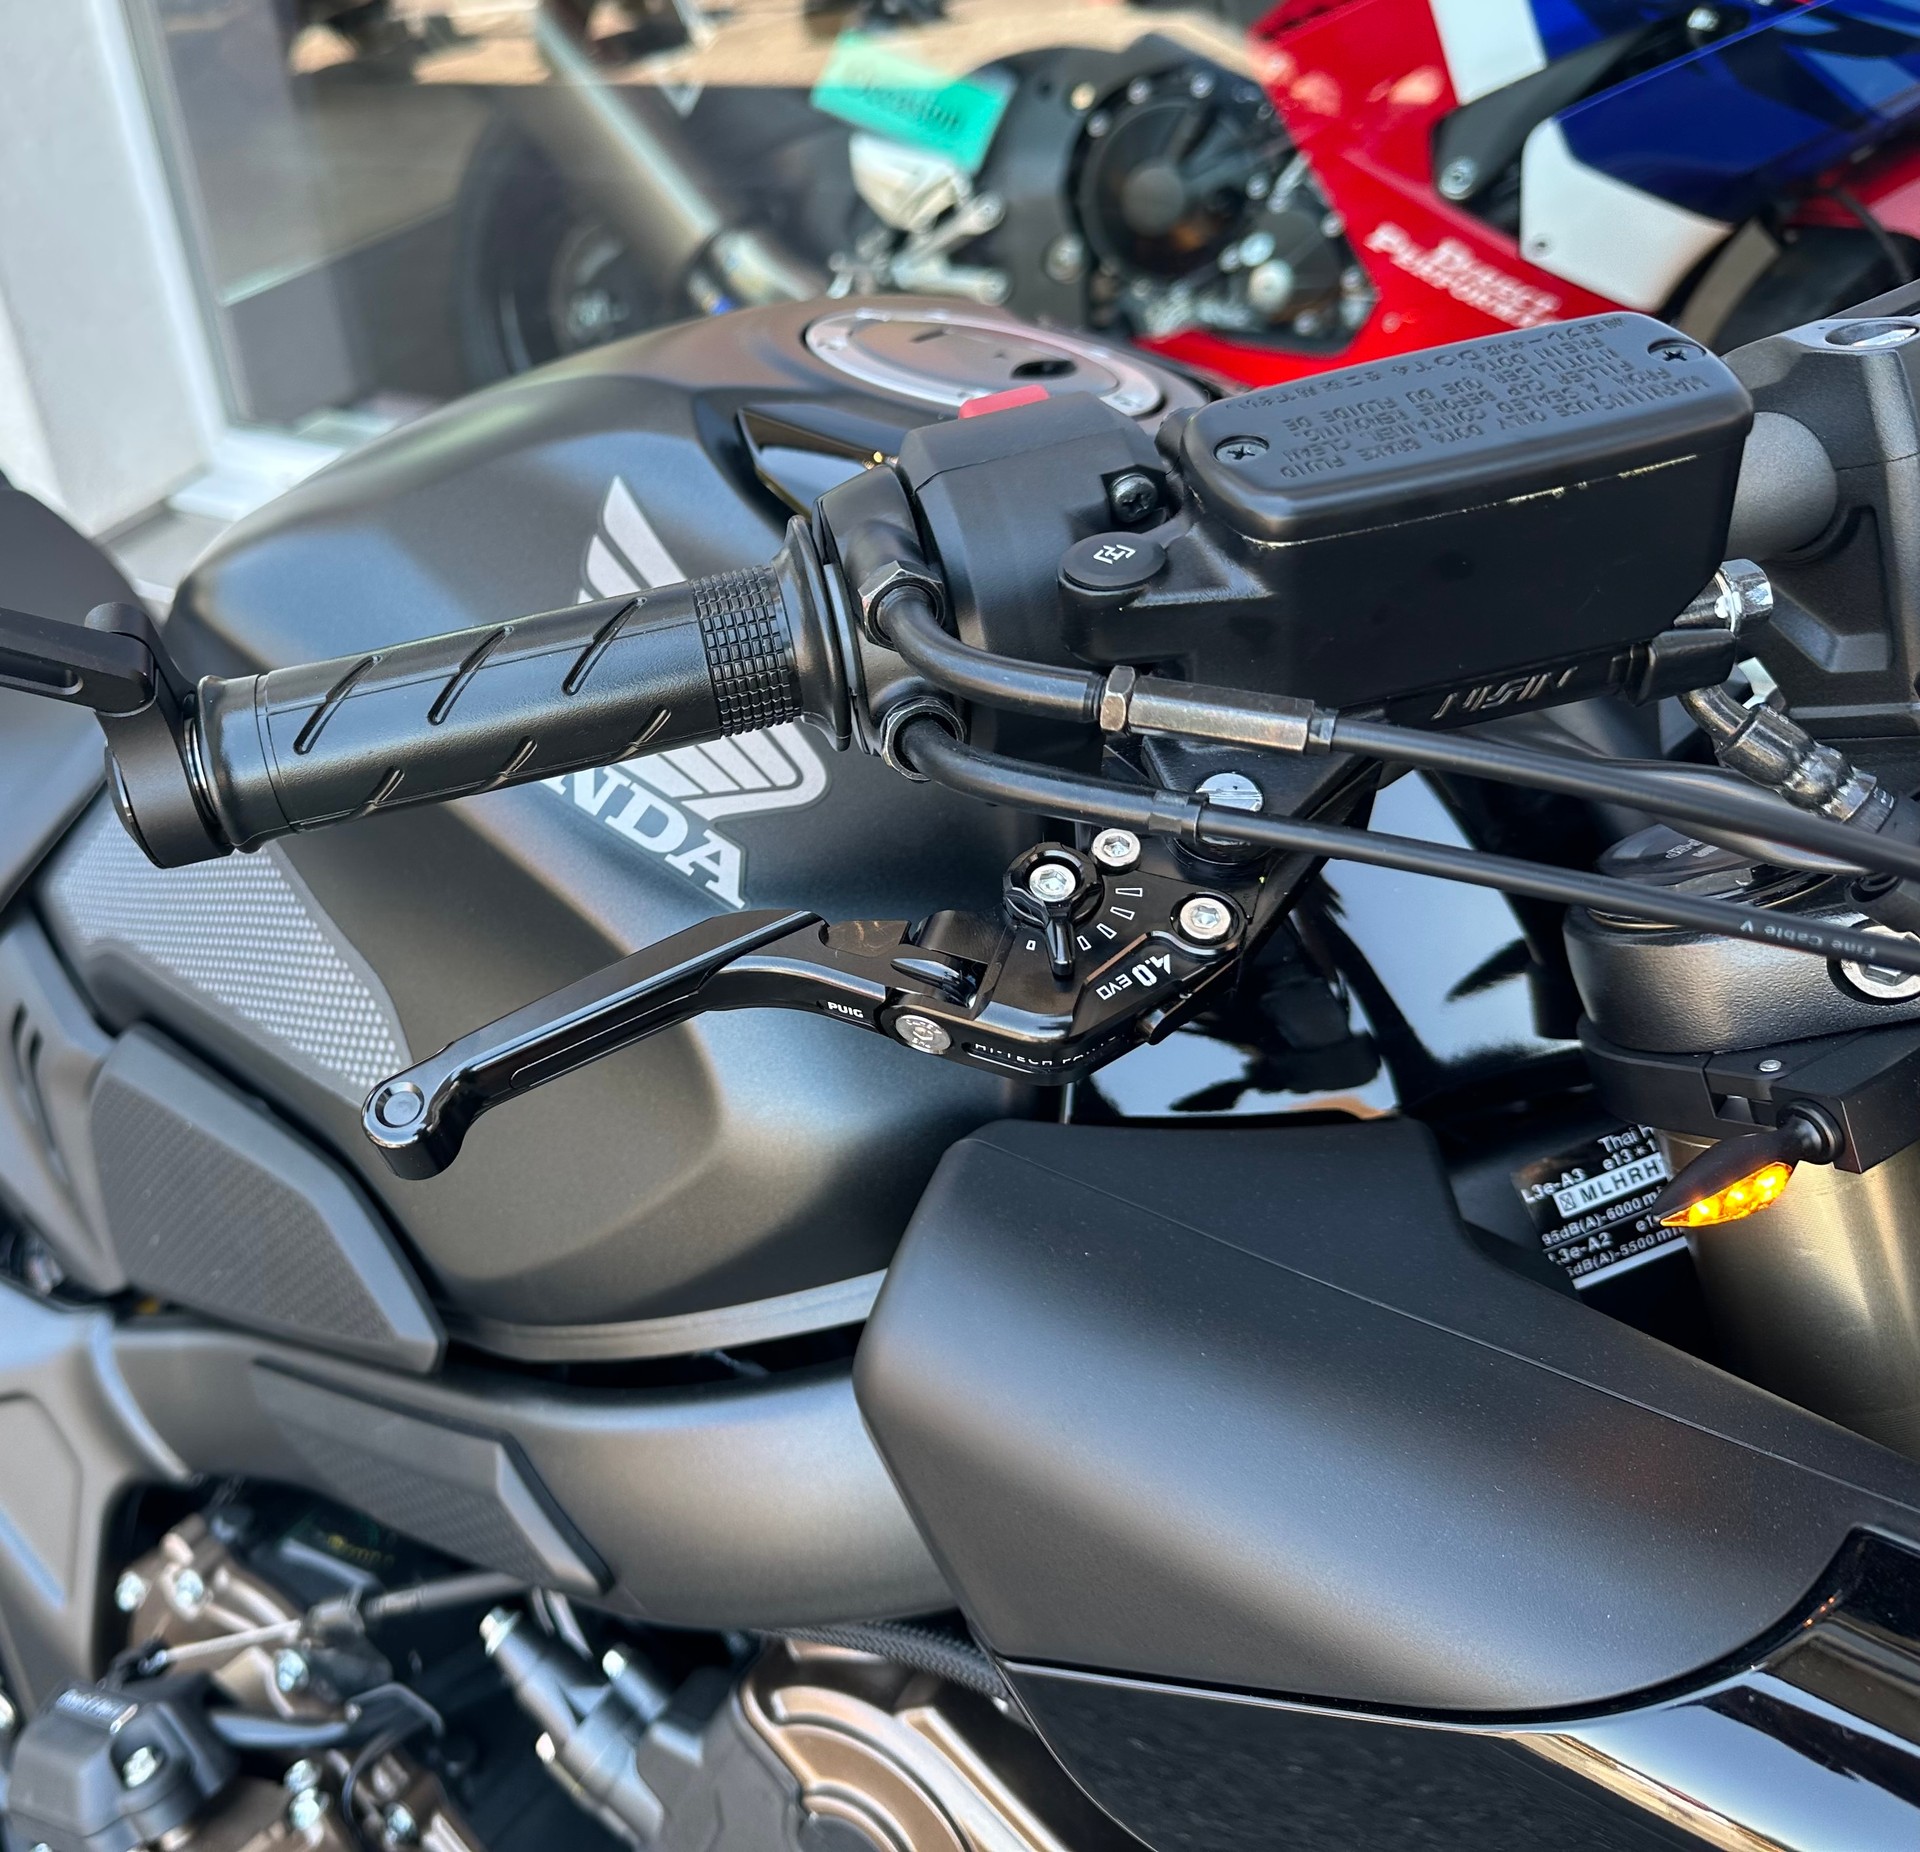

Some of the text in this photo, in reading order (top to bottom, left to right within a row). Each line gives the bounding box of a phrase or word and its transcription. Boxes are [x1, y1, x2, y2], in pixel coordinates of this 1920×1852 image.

[1764, 924, 1823, 946] Cable
[1831, 939, 1876, 958] Fine
[1095, 953, 1171, 1001] 4.0 EVO
[827, 1001, 864, 1018] PUIG
[1597, 1127, 1638, 1153] Thai
[1520, 1168, 1587, 1204] L3e-A3
